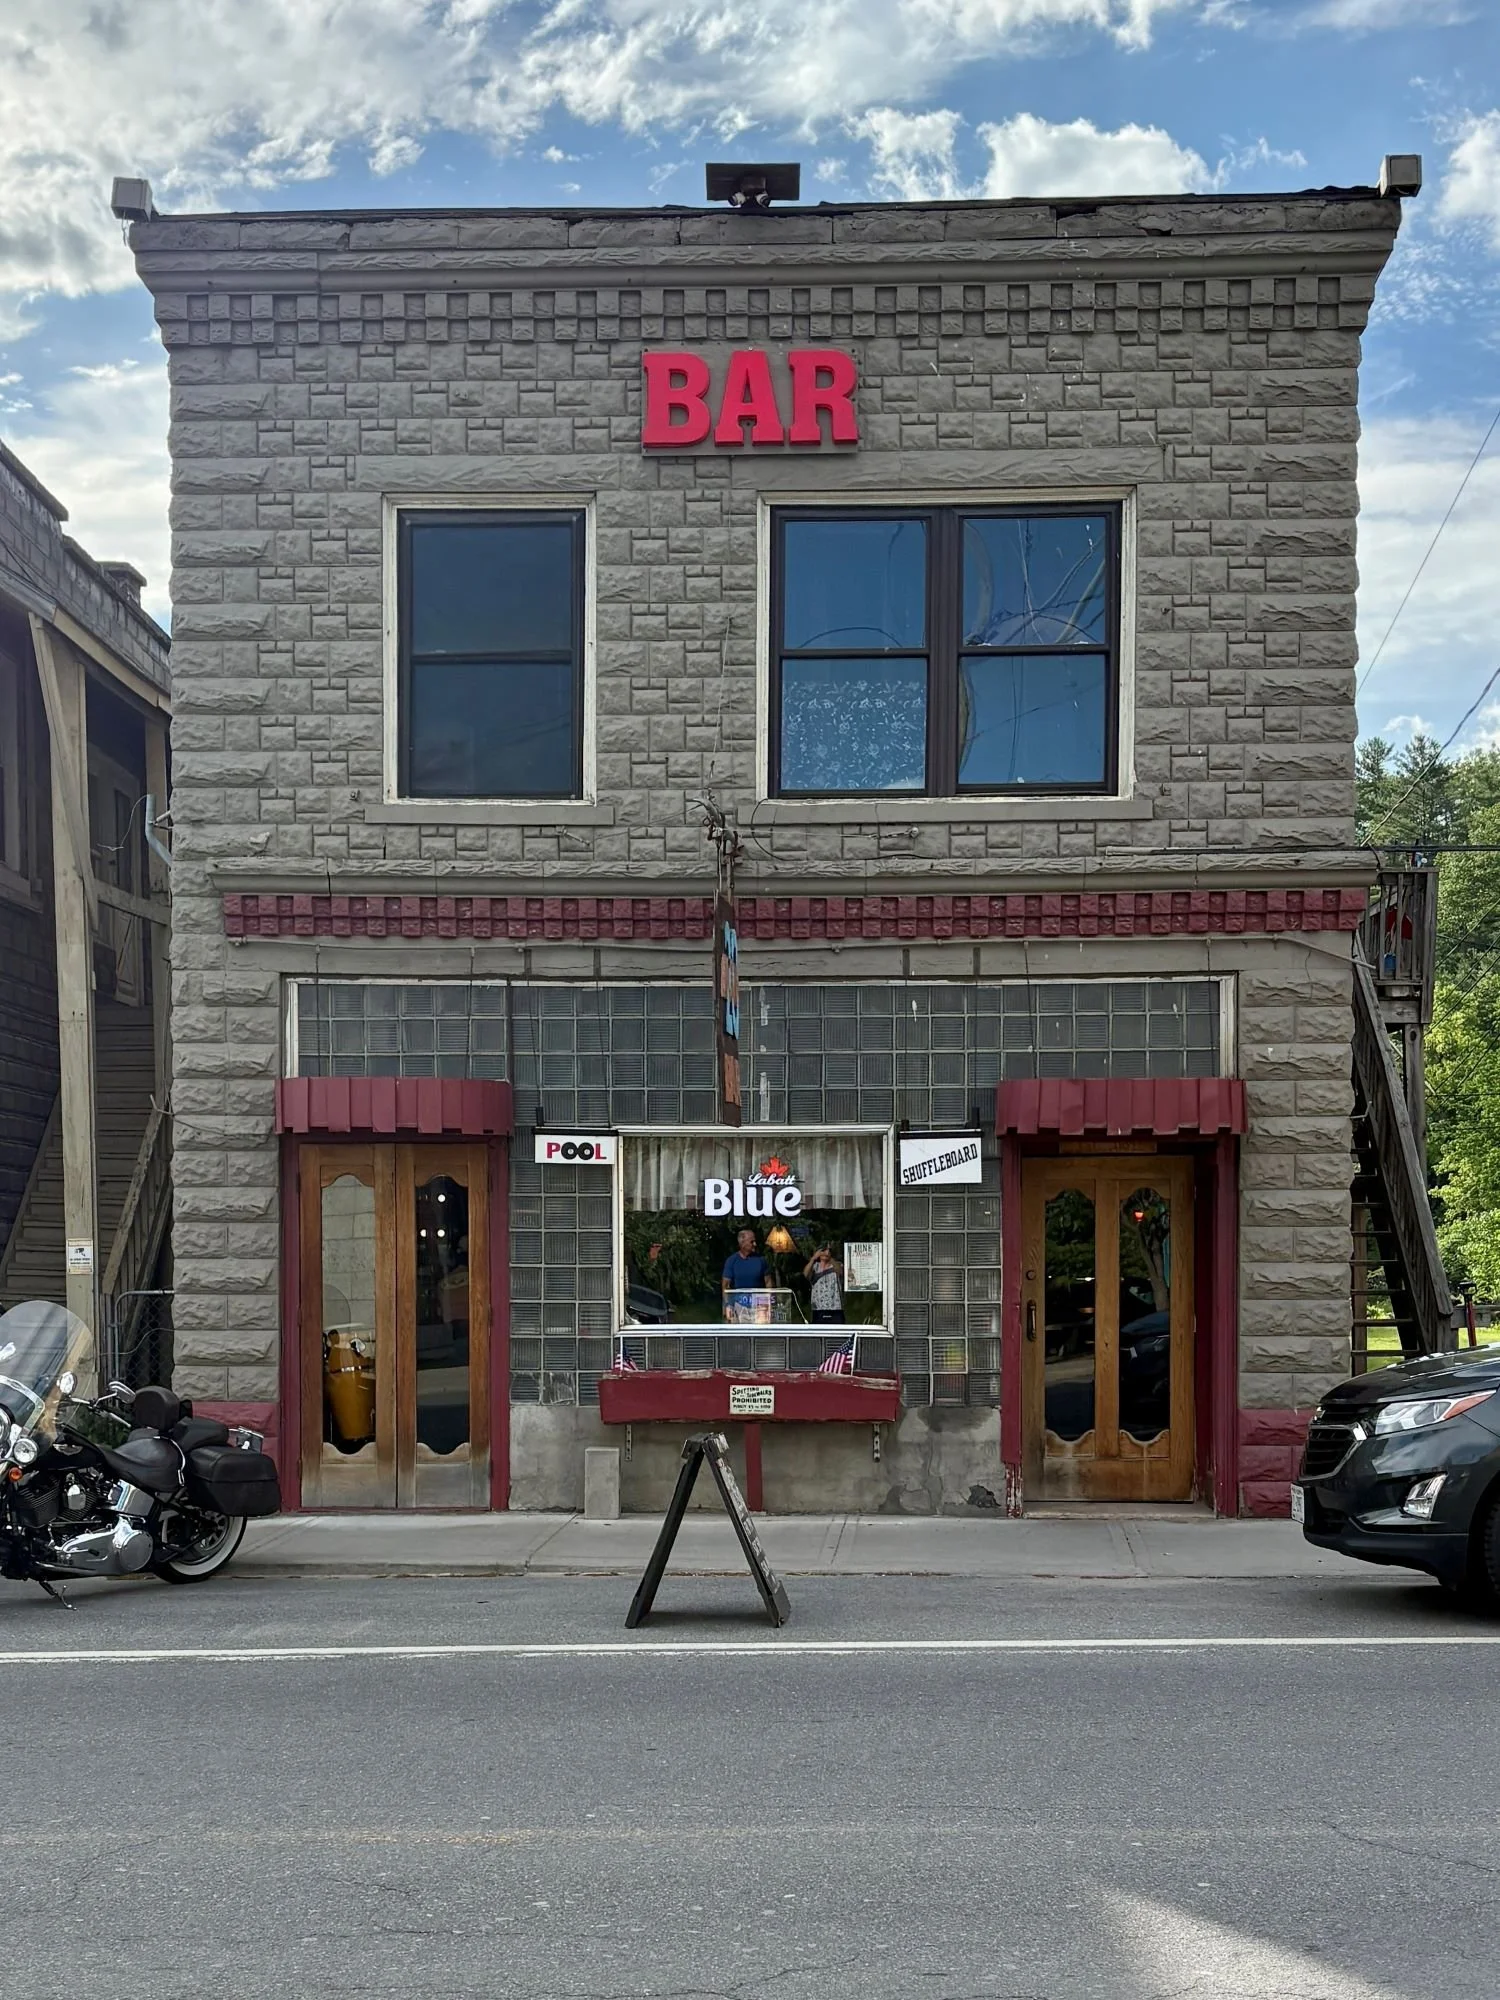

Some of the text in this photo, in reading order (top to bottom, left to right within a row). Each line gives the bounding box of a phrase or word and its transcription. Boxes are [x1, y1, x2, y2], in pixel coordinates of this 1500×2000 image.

[642, 349, 858, 448] BAR
[546, 1141, 607, 1160] POOL
[902, 1143, 978, 1184] SHUFFLEBOARD
[704, 1178, 802, 1217] Blue
[746, 1172, 796, 1186] Labatt
